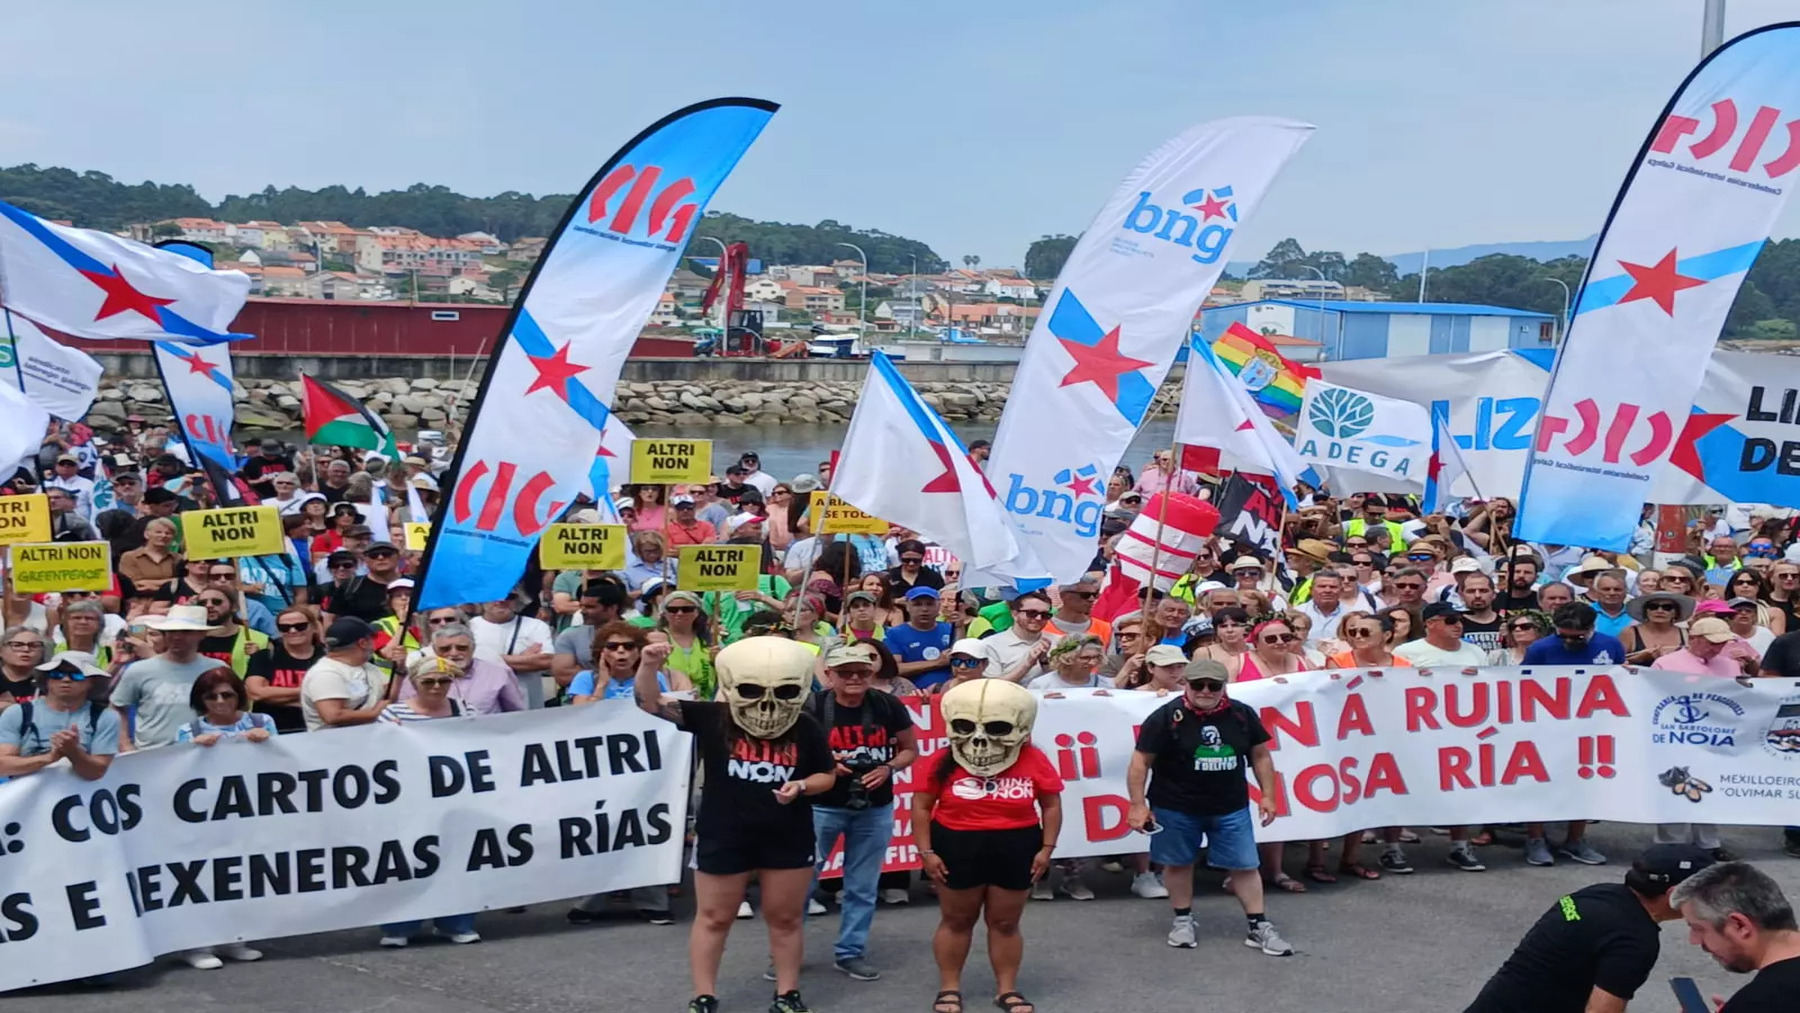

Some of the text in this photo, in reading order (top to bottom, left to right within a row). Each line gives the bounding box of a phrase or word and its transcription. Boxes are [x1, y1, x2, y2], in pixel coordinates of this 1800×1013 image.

[588, 163, 698, 243] CIG
[1123, 191, 1233, 264] bng
[1746, 386, 1800, 425] LI
[1431, 397, 1541, 450] LIZ
[647, 444, 695, 456] ALTRI
[1300, 439, 1411, 475] ADEGA
[653, 457, 689, 469] NON
[454, 459, 568, 537] CIG
[1005, 473, 1102, 538] bng
[0, 501, 30, 514] TRI
[843, 510, 873, 518] TOC
[0, 516, 27, 528] ON
[203, 511, 259, 528] ALTRI
[211, 526, 255, 542] NON
[558, 528, 608, 540] ALTRI
[21, 547, 101, 561] ALTRI NON
[564, 542, 602, 554] NON
[695, 550, 744, 562] ALTRI
[18, 568, 105, 583] GREENPEACE
[700, 564, 737, 576] NON
[1337, 675, 1376, 740] Á
[1405, 674, 1631, 732] RUINA
[1652, 731, 1735, 746] DE NOIA
[1438, 726, 1616, 792] RÍA !!
[728, 759, 796, 783] NON
[52, 729, 662, 843] COS CARTOS DE ALTRI
[65, 880, 107, 931] E
[466, 824, 534, 871] AS
[558, 799, 672, 859] RÍAS
